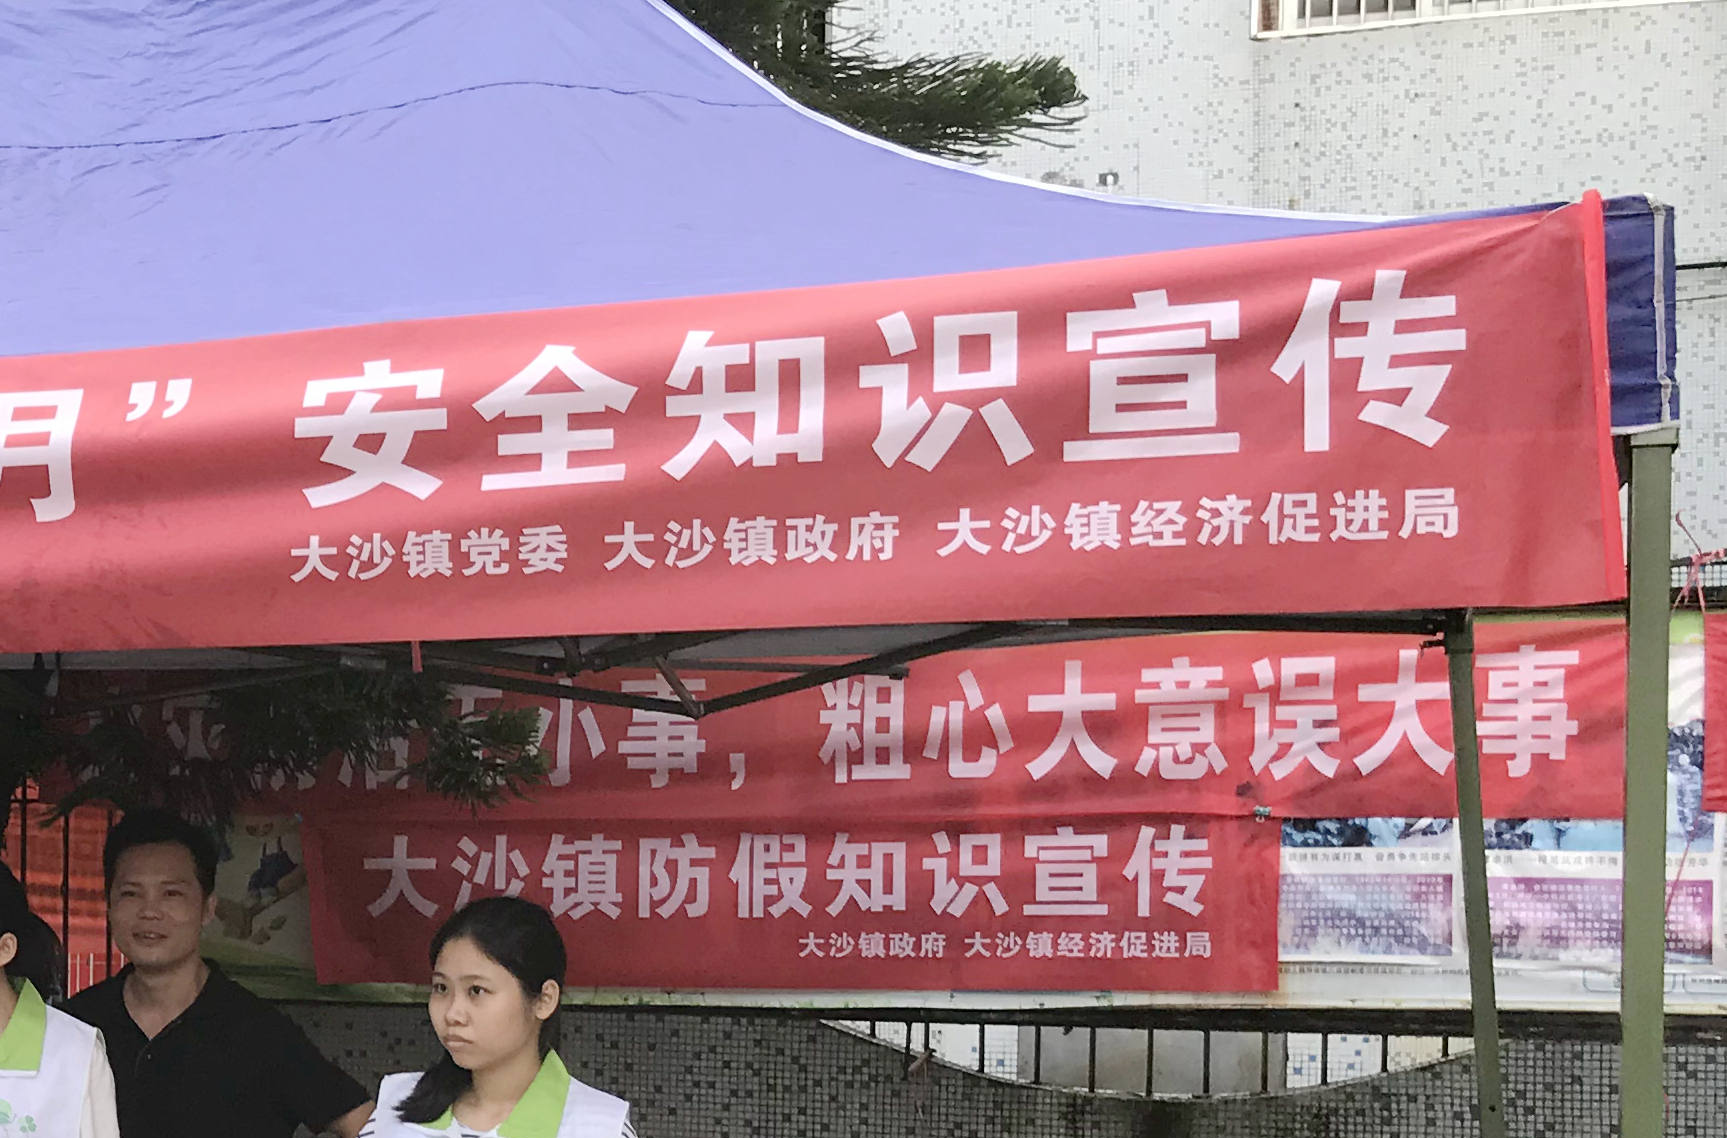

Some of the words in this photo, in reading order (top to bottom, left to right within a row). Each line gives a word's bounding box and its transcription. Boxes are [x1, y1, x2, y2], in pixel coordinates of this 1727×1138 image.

[292, 266, 1468, 510] 安全知识宣传
[290, 525, 569, 584] 大沙镇党委
[604, 511, 900, 572] 大沙镇政府
[936, 486, 1460, 556] 大沙镇经济促进局
[363, 824, 1214, 921] 大沙镇防假知识宣传
[798, 928, 947, 960] 大沙镇政府
[964, 924, 1213, 960] 大沙镇经济促进局
